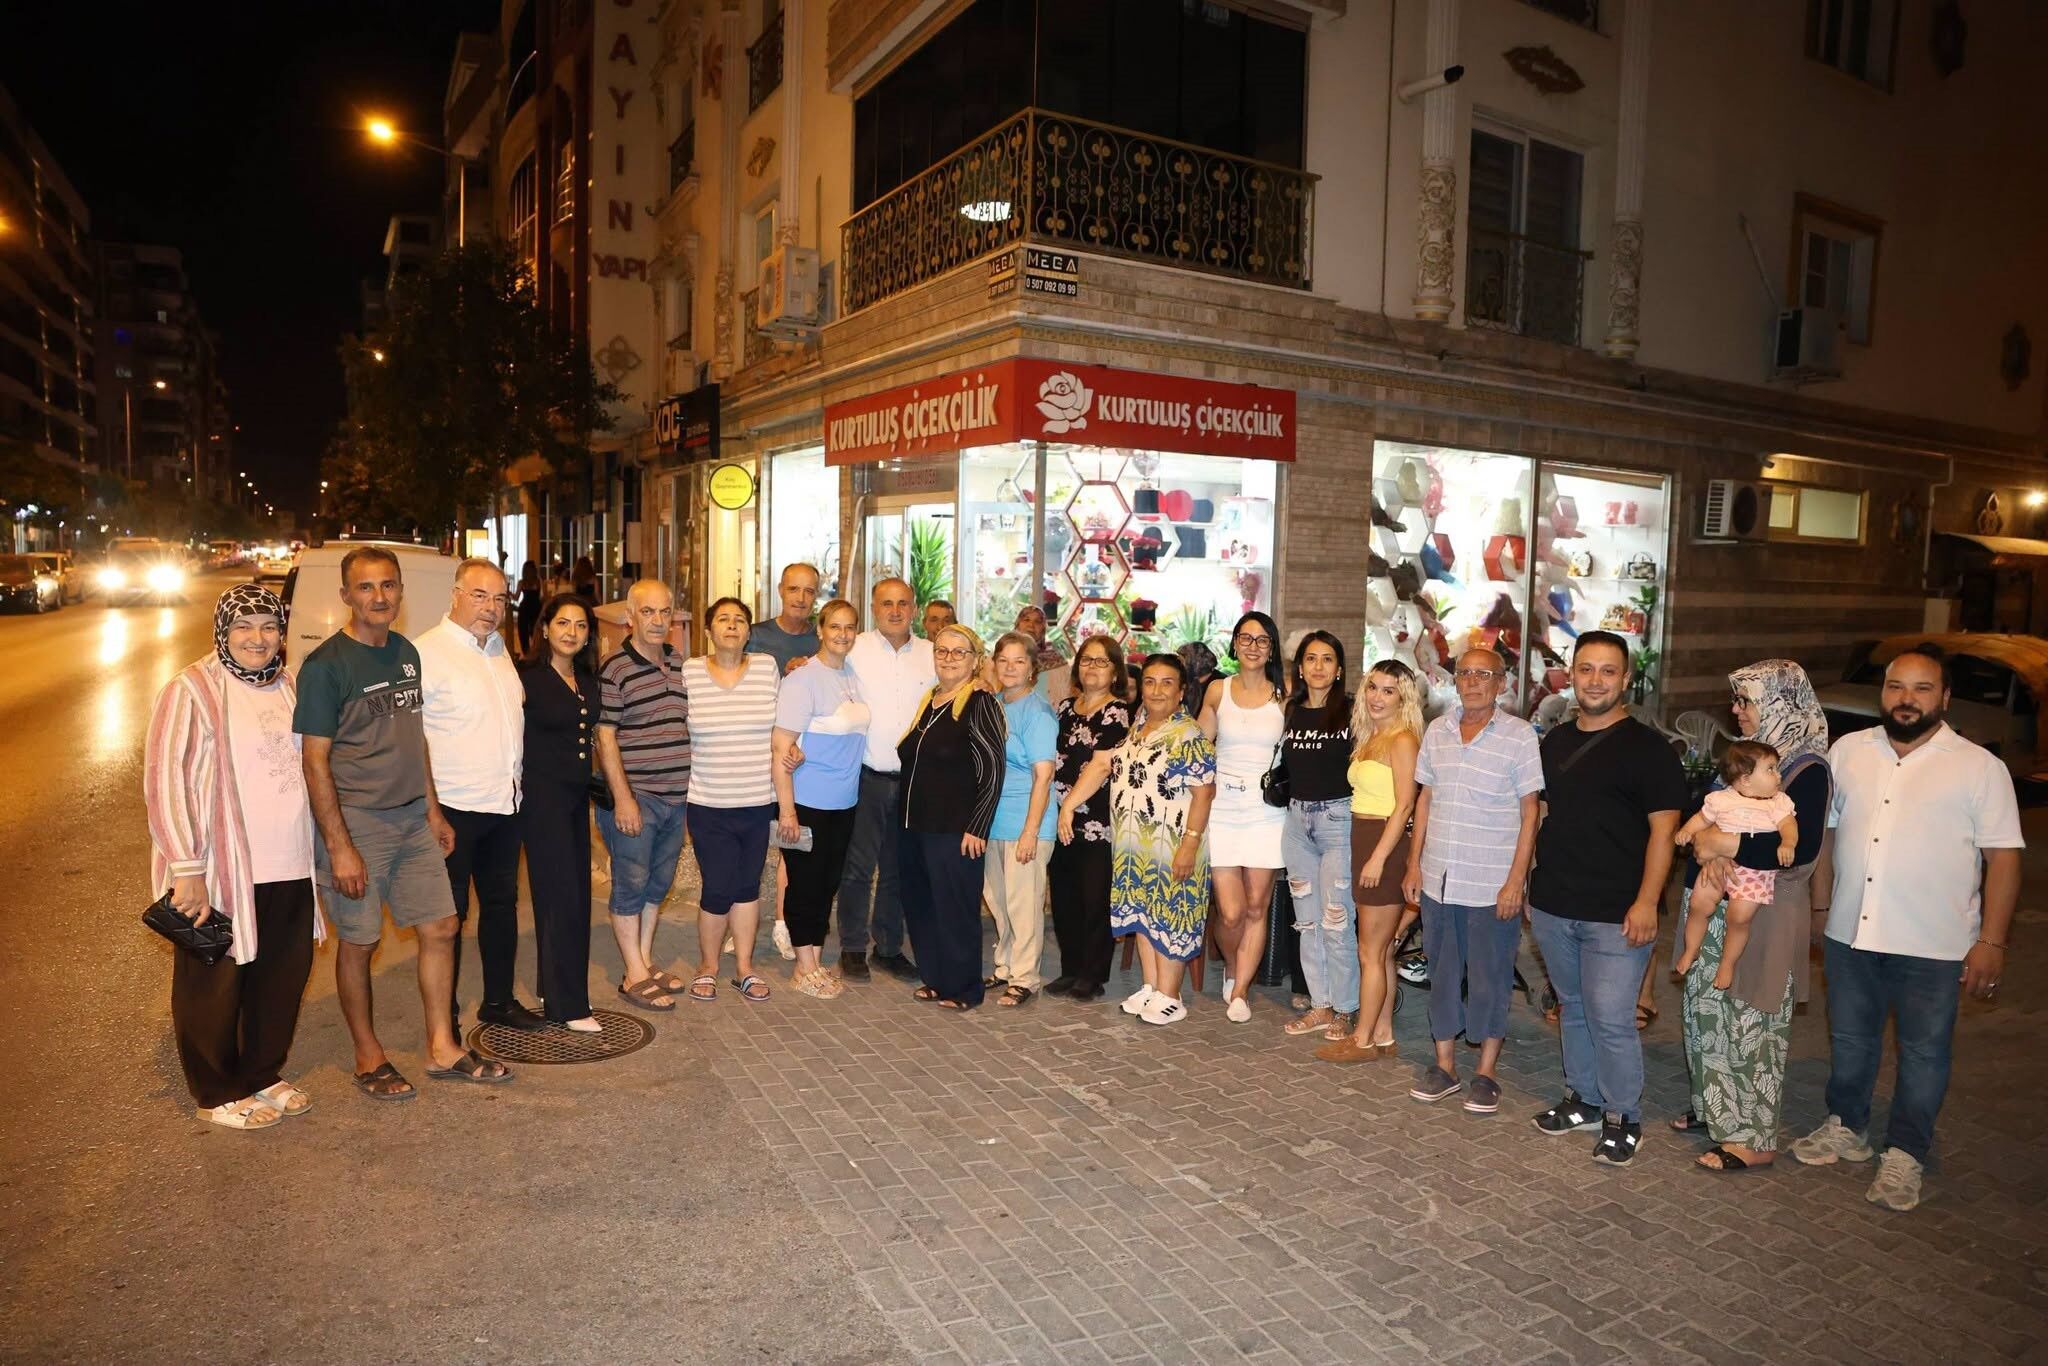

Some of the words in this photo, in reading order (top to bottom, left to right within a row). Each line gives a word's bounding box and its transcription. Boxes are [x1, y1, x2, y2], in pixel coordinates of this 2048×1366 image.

[608, 0, 638, 232] AYIN
[593, 253, 647, 282] YAPI
[1027, 251, 1077, 273] MEGA
[1026, 278, 1031, 289] 0
[1031, 279, 1043, 290] 507
[1044, 281, 1057, 293] 092
[1057, 283, 1067, 294] 09
[1067, 284, 1077, 295] 99
[830, 406, 899, 452] KURTULUŞ
[903, 373, 999, 450] ÇİÇEKÇİLİK
[1098, 395, 1191, 435] KURTULUŞ
[1196, 397, 1284, 440] ÇİÇEKÇİLİK
[1293, 742, 1322, 750] PARIS
